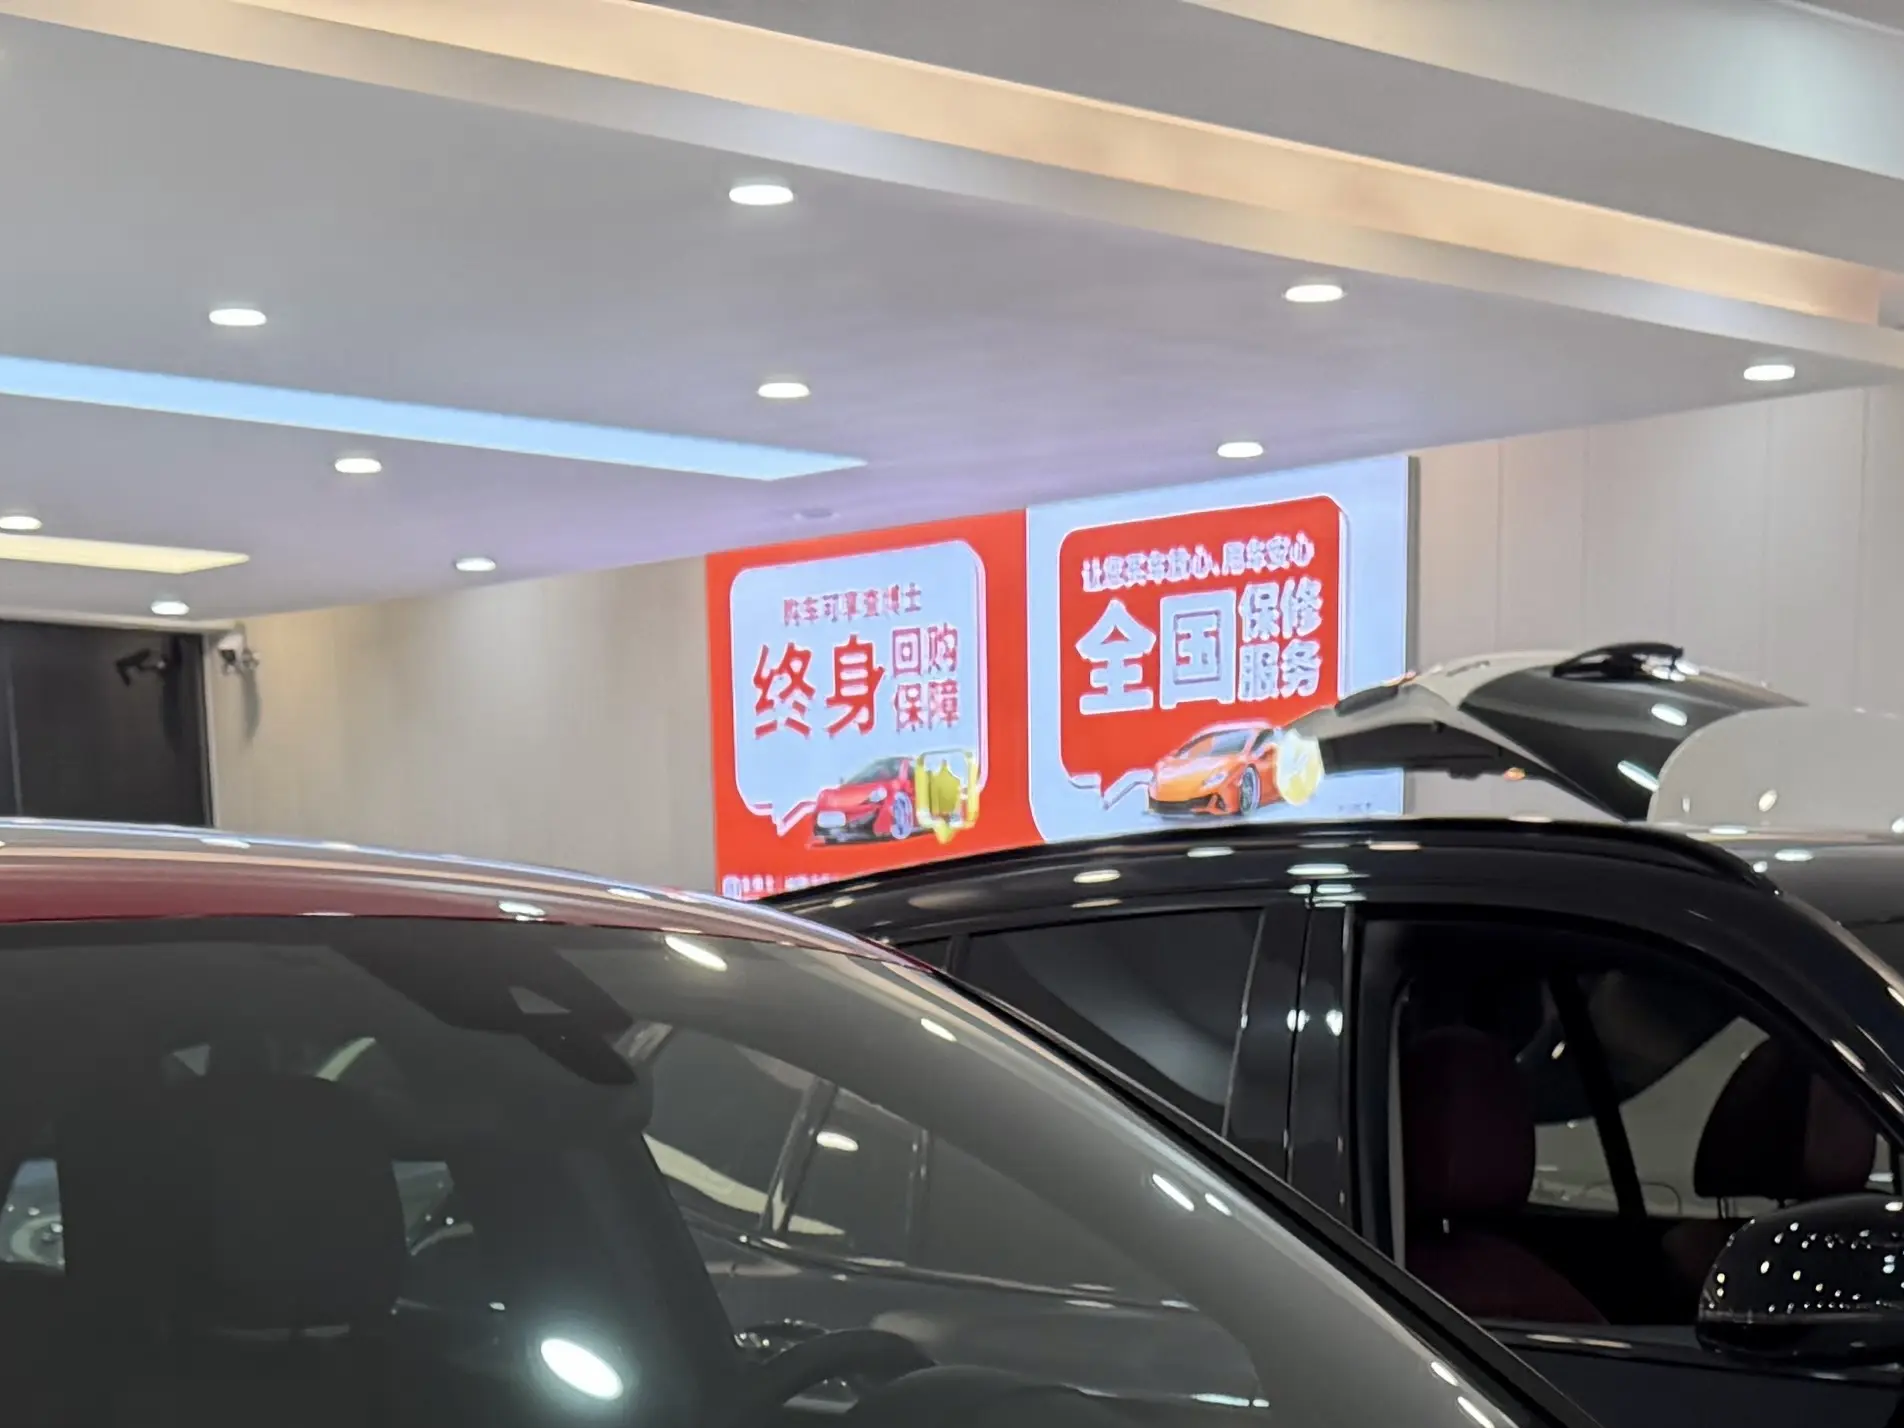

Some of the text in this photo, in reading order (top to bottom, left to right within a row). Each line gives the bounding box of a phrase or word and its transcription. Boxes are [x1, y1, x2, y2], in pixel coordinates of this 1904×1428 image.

[1239, 576, 1324, 642] 保修
[892, 623, 959, 677] 回购
[1075, 590, 1237, 715] 全国
[1238, 638, 1323, 701] 服务
[753, 633, 886, 740] 终身
[895, 679, 959, 733] 保障
